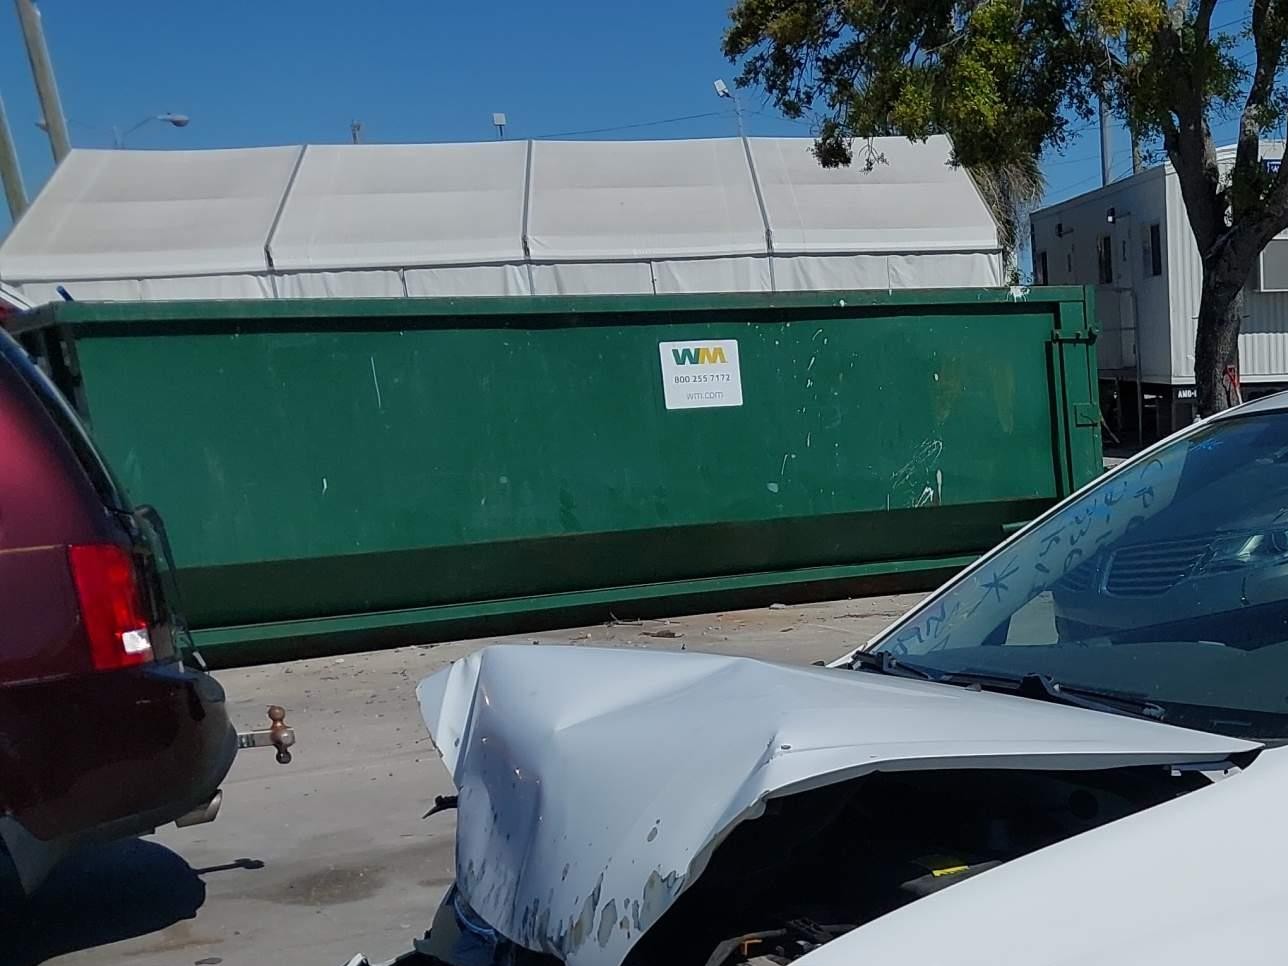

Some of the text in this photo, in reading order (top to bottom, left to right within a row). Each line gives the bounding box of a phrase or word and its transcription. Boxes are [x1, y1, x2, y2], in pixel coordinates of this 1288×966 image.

[672, 347, 726, 365] WM
[693, 375, 708, 383] 255
[710, 374, 730, 382] 7172
[687, 391, 723, 400] wm.com
